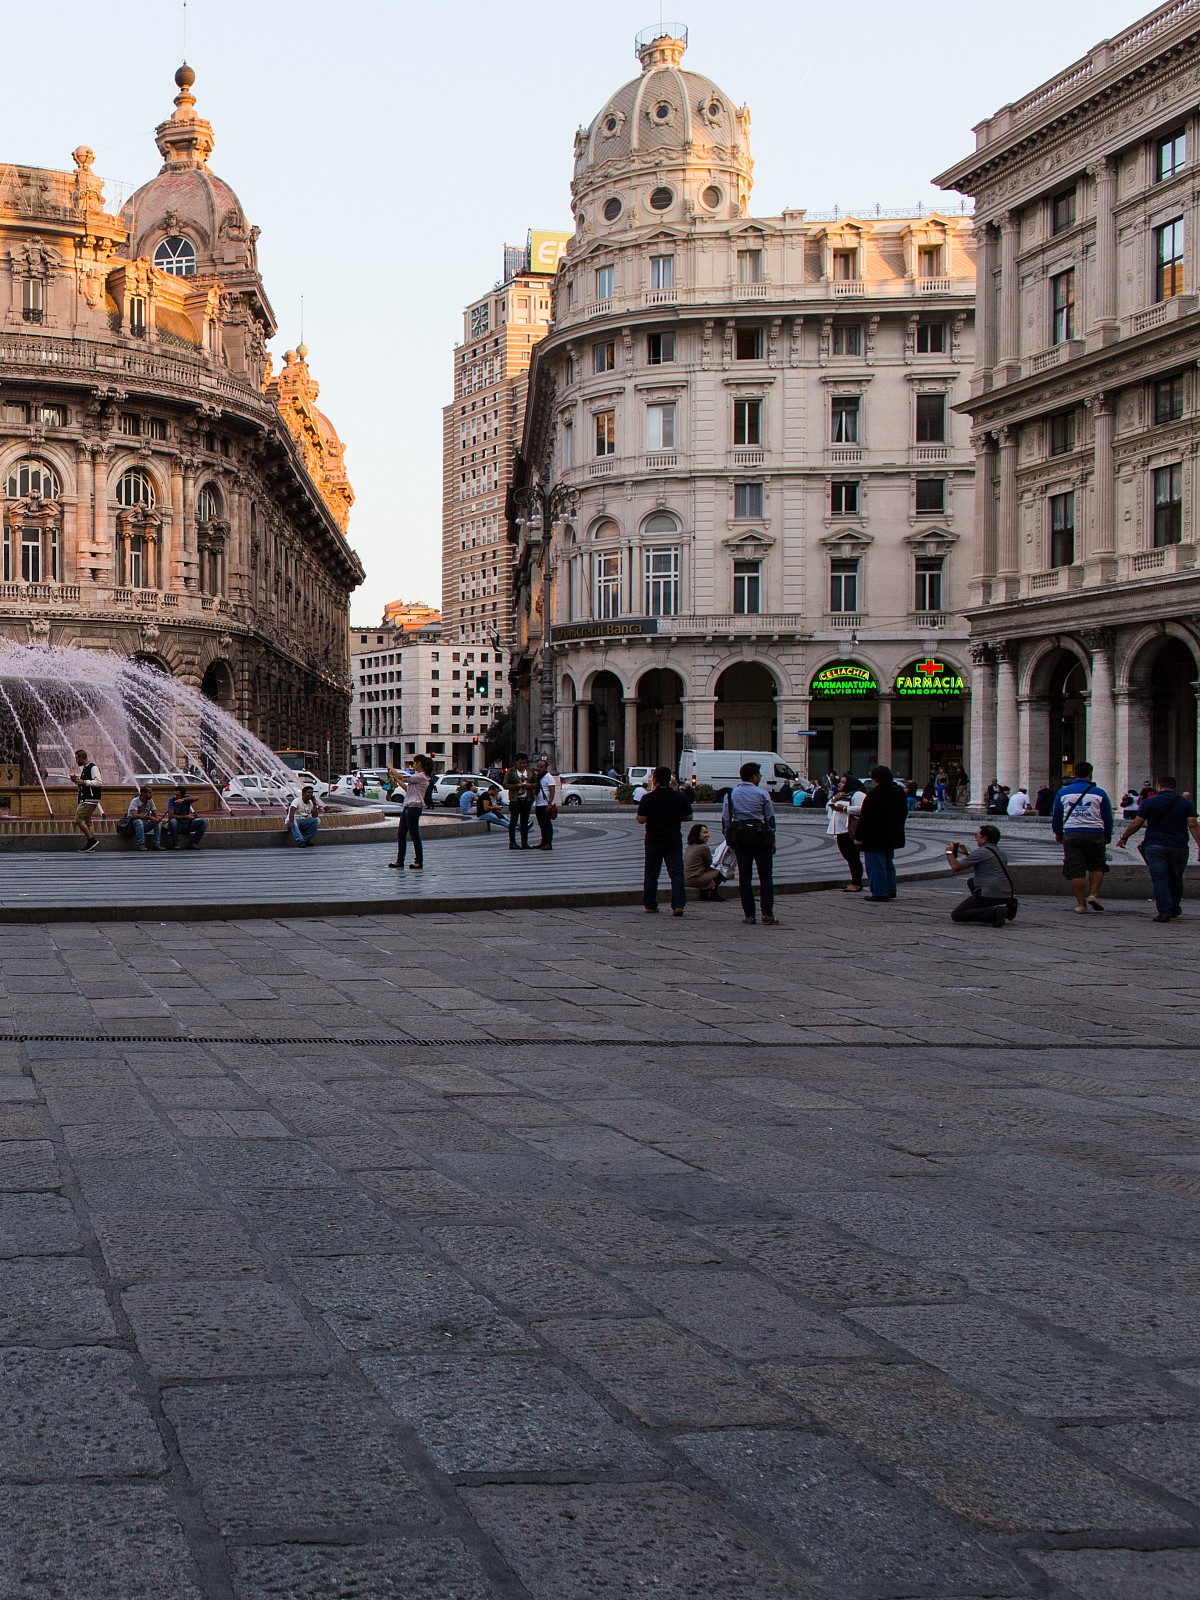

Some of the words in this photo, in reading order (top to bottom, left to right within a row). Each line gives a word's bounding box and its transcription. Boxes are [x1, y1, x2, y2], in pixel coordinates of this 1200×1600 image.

[565, 624, 604, 640] UniCredit
[607, 623, 642, 635] Banca
[820, 667, 870, 681] CELIACHIA
[812, 681, 877, 689] FARMANATURA
[896, 676, 964, 688] FARMACIA
